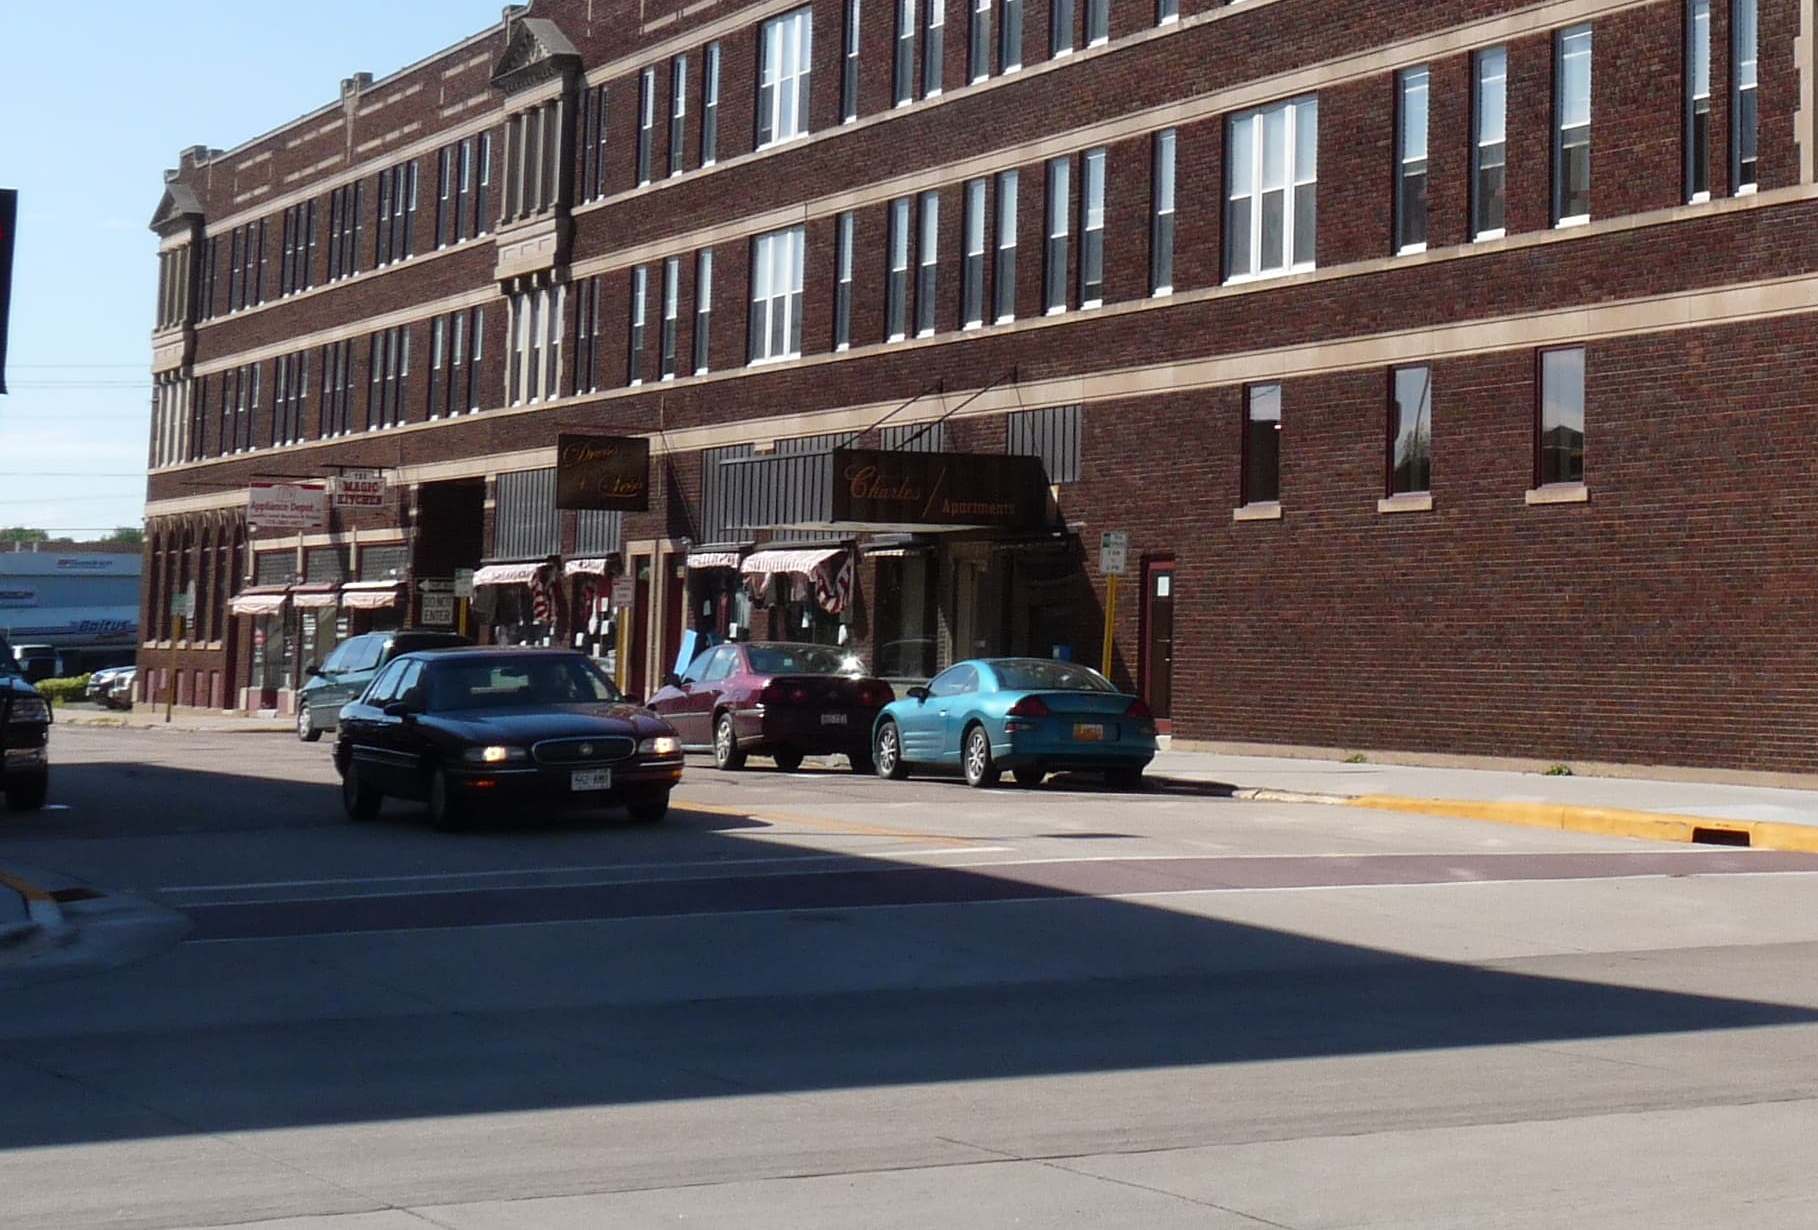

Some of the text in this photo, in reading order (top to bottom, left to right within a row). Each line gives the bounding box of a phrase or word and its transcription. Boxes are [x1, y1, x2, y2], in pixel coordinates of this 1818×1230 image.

[343, 481, 379, 492] MAGIC
[844, 465, 921, 500] Charles
[337, 495, 383, 506] KITCHEN
[251, 501, 314, 513] Appliance Depot
[942, 498, 1016, 517] Apartments
[424, 609, 451, 622] ENTER
